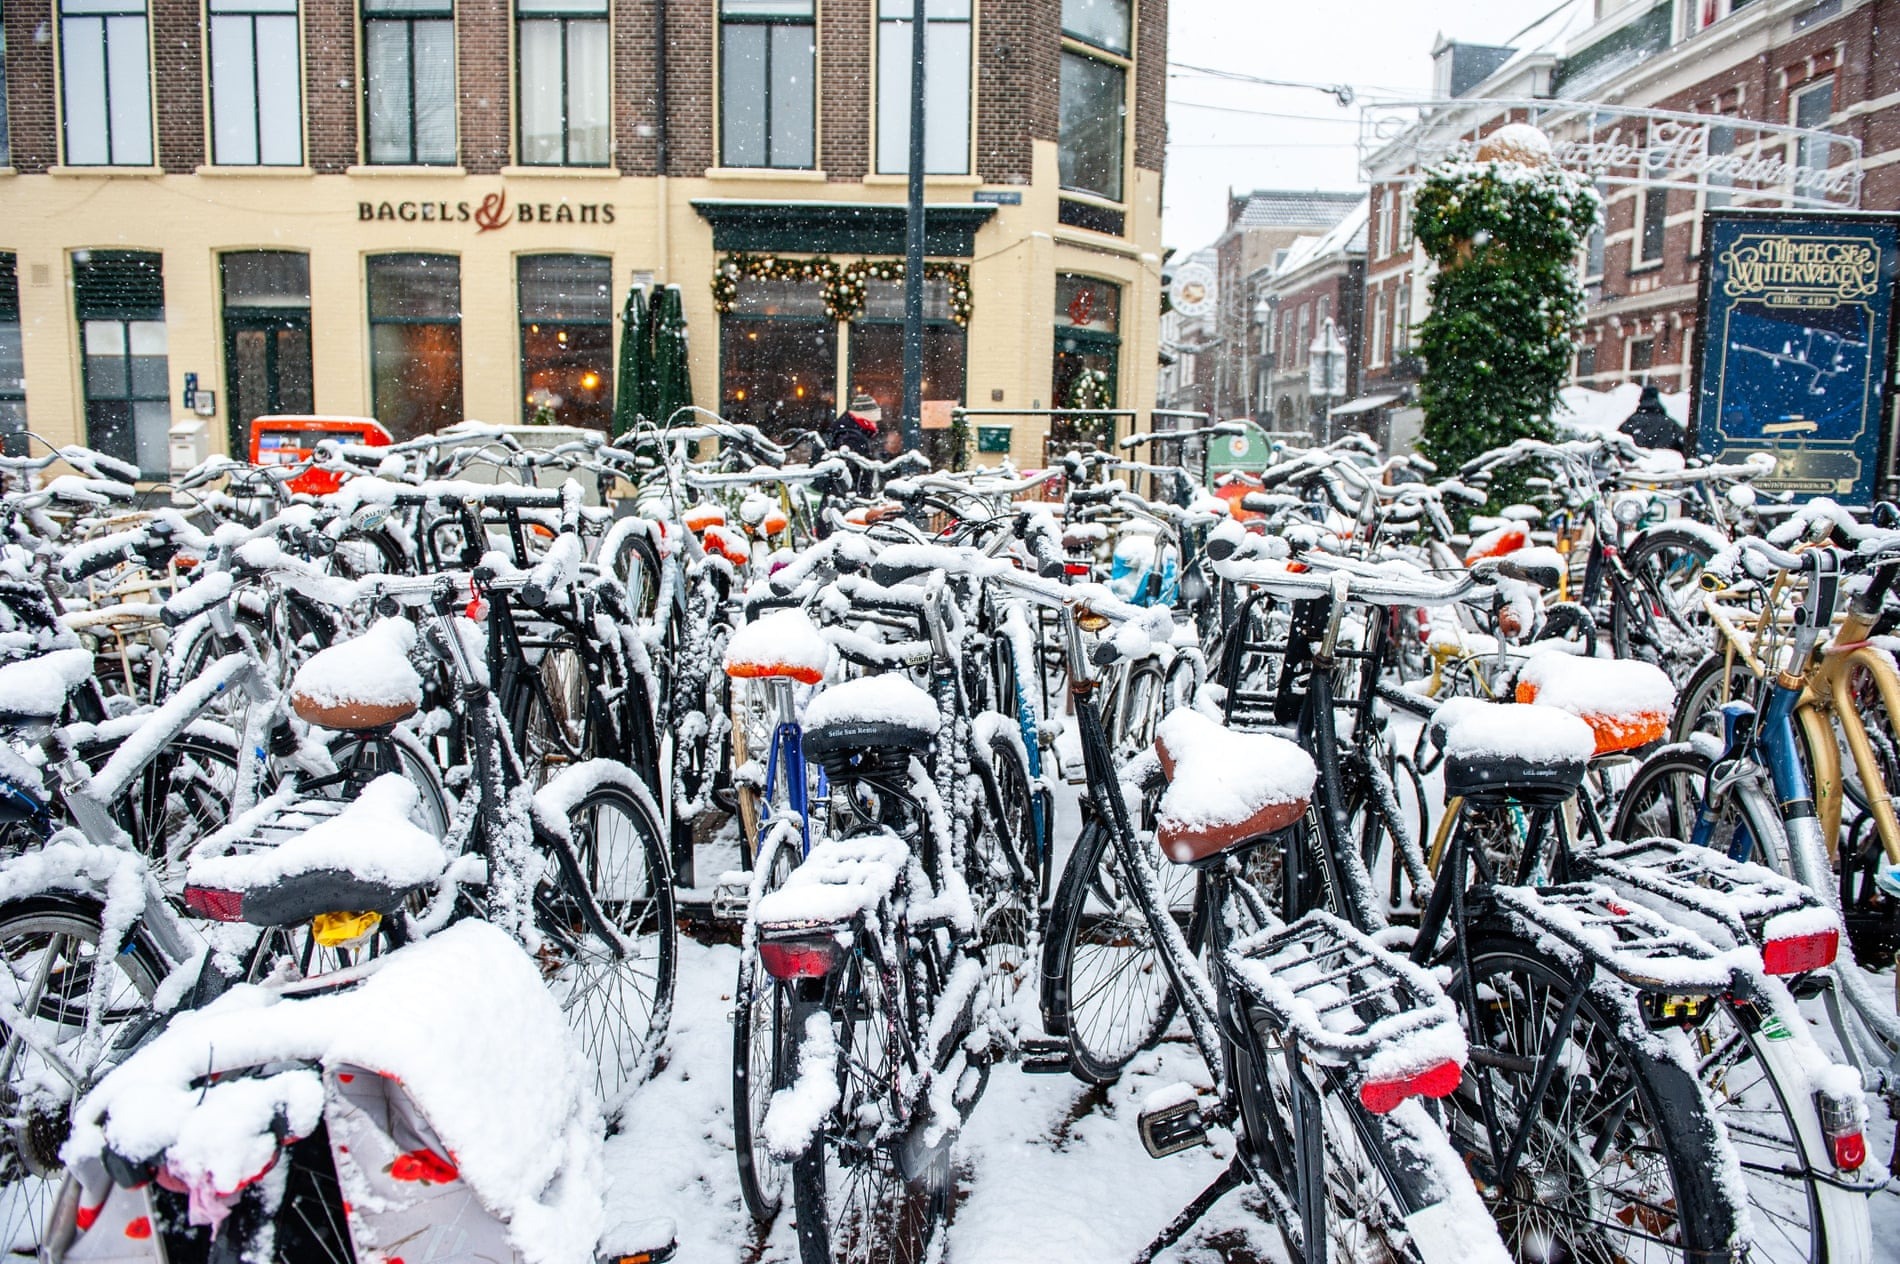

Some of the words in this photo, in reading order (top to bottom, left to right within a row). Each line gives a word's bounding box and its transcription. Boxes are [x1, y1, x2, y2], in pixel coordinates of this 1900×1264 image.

[357, 201, 471, 222] BAGELS
[475, 186, 513, 235] &
[517, 202, 616, 223] BEANS
[1722, 254, 1876, 293] WINTERWEKEN
